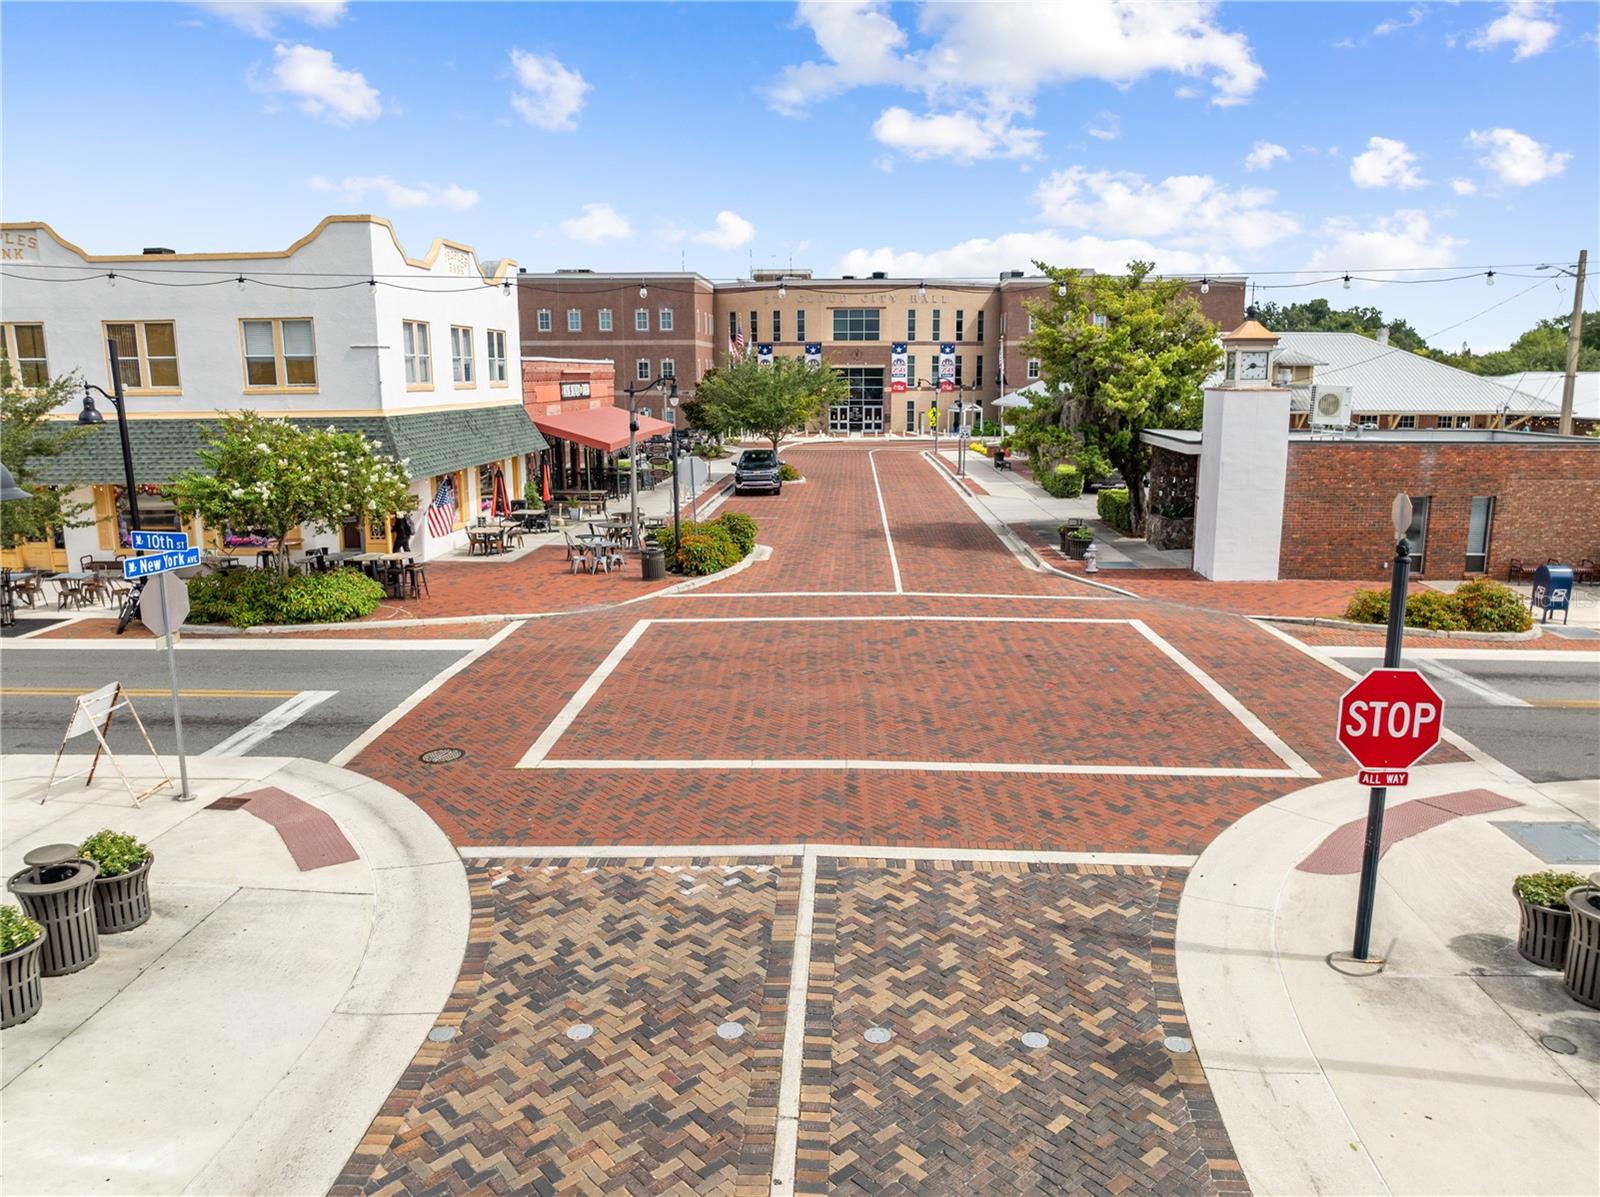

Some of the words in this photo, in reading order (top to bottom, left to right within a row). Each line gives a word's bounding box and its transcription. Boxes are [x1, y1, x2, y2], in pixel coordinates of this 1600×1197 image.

[860, 294, 897, 304] CITY
[910, 294, 949, 304] HALL
[146, 534, 174, 549] 10th
[176, 541, 185, 549] ST
[140, 558, 161, 574] New
[162, 552, 185, 569] York
[186, 554, 198, 564] AVE
[1345, 700, 1437, 738] STOP
[1362, 773, 1382, 785] ALL
[1386, 773, 1407, 785] WAY
